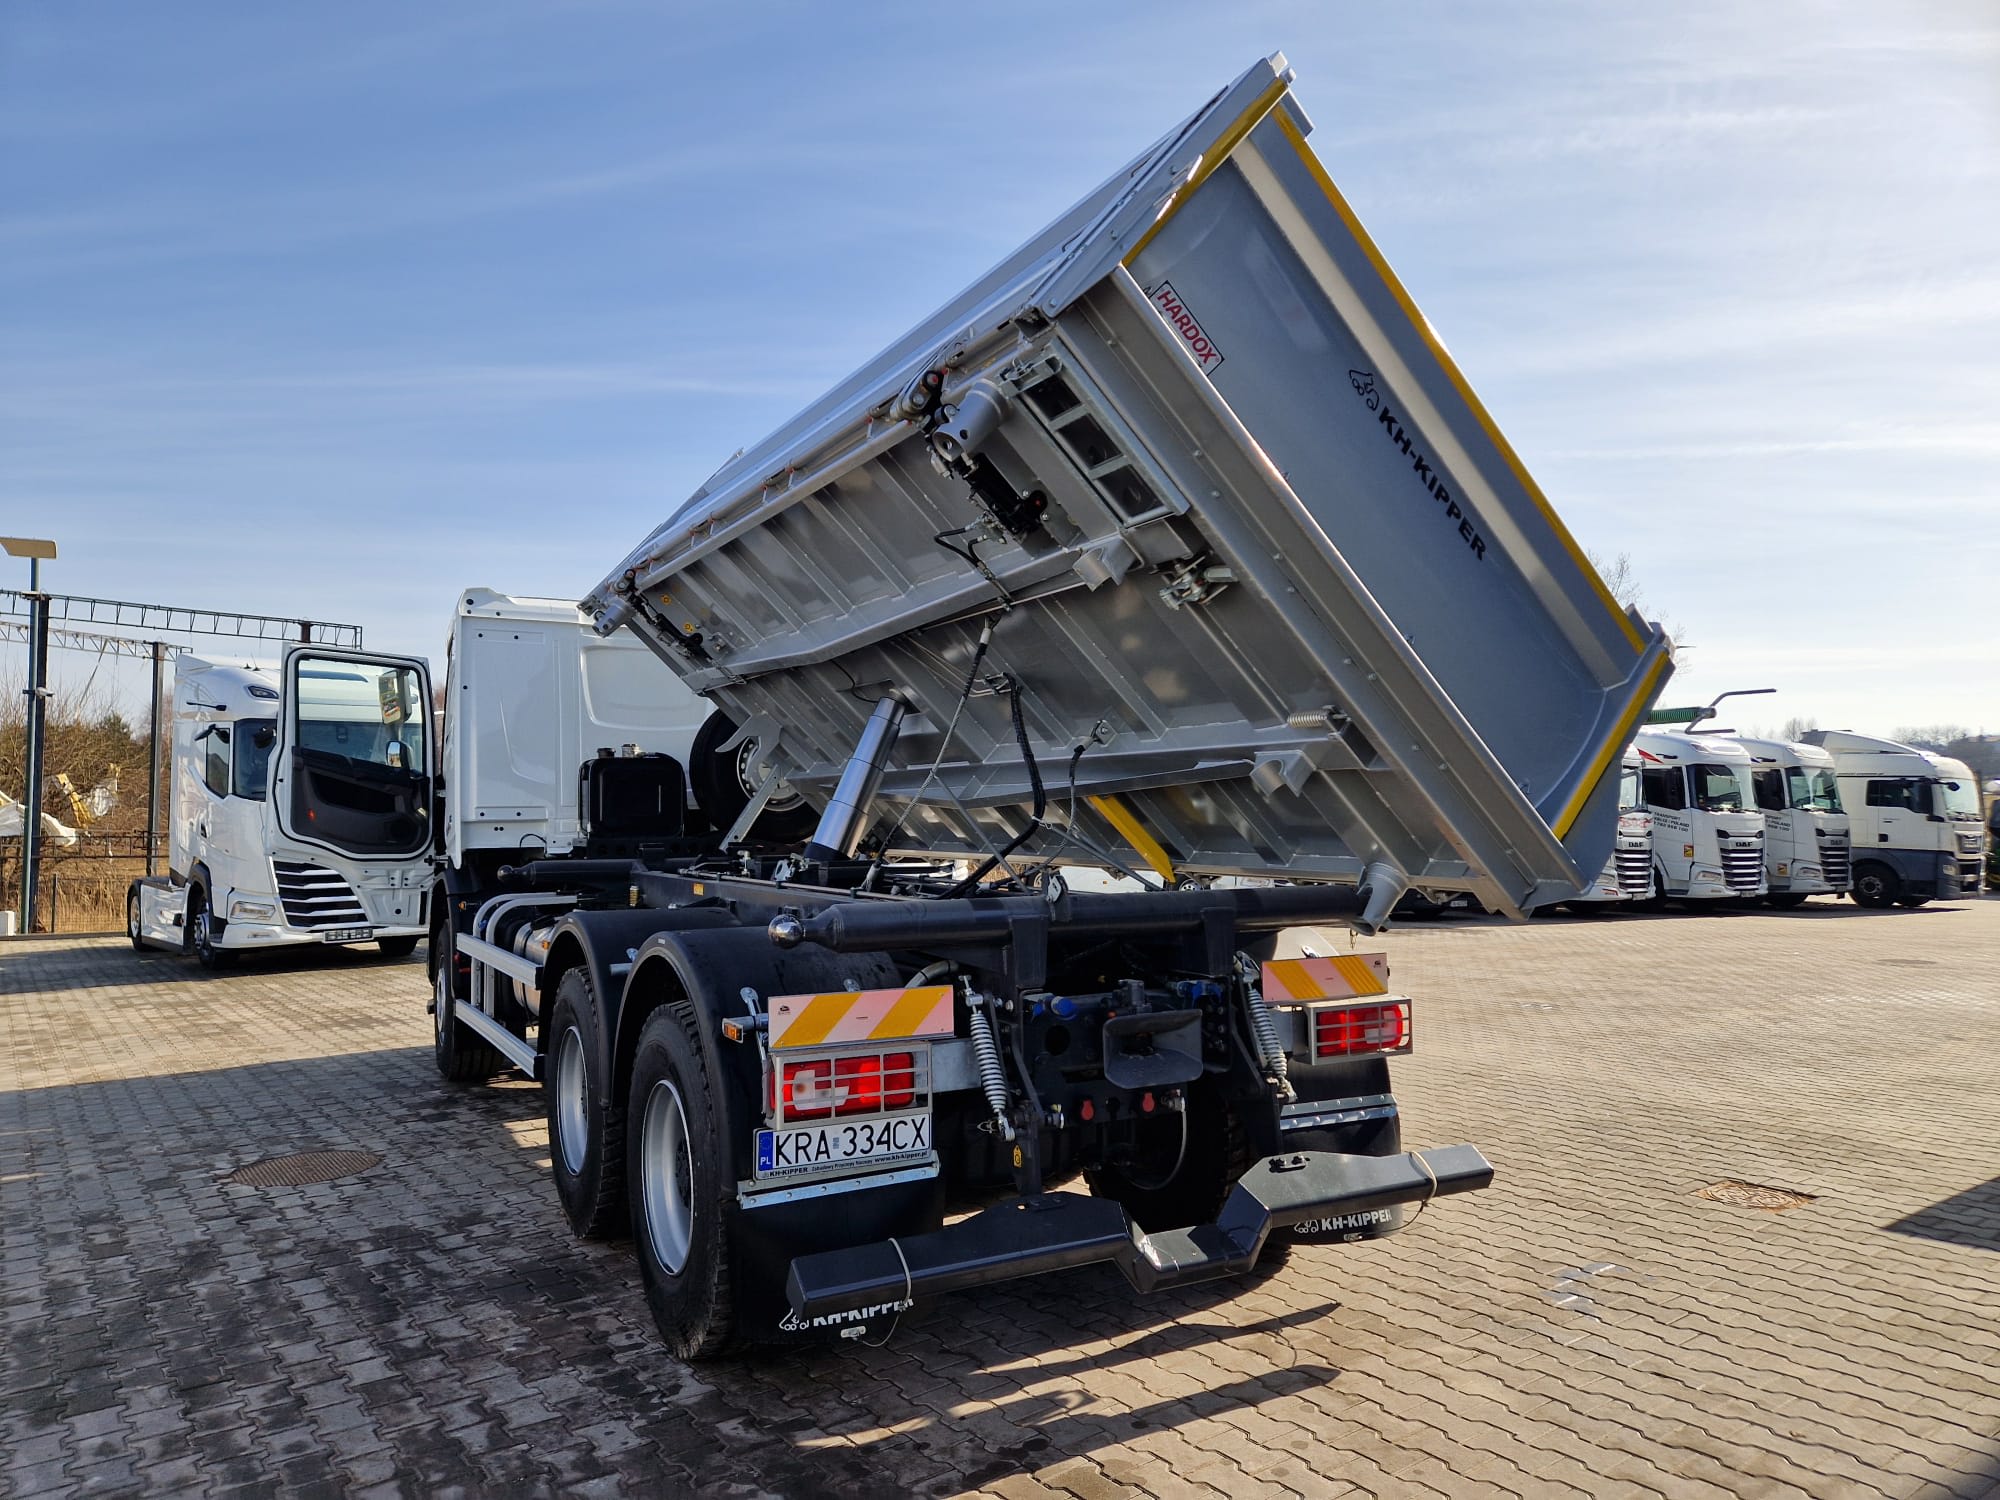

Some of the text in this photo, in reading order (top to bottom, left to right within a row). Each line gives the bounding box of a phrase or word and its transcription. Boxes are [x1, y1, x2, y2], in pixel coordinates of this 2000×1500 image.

[1157, 290, 1217, 364] HARDOX
[1378, 406, 1486, 561] KH-KIPPER
[760, 1117, 926, 1167] PL KRA 334CX
[769, 1167, 809, 1178] KH-KIPPER
[1321, 1208, 1393, 1231] KH-KIPPER
